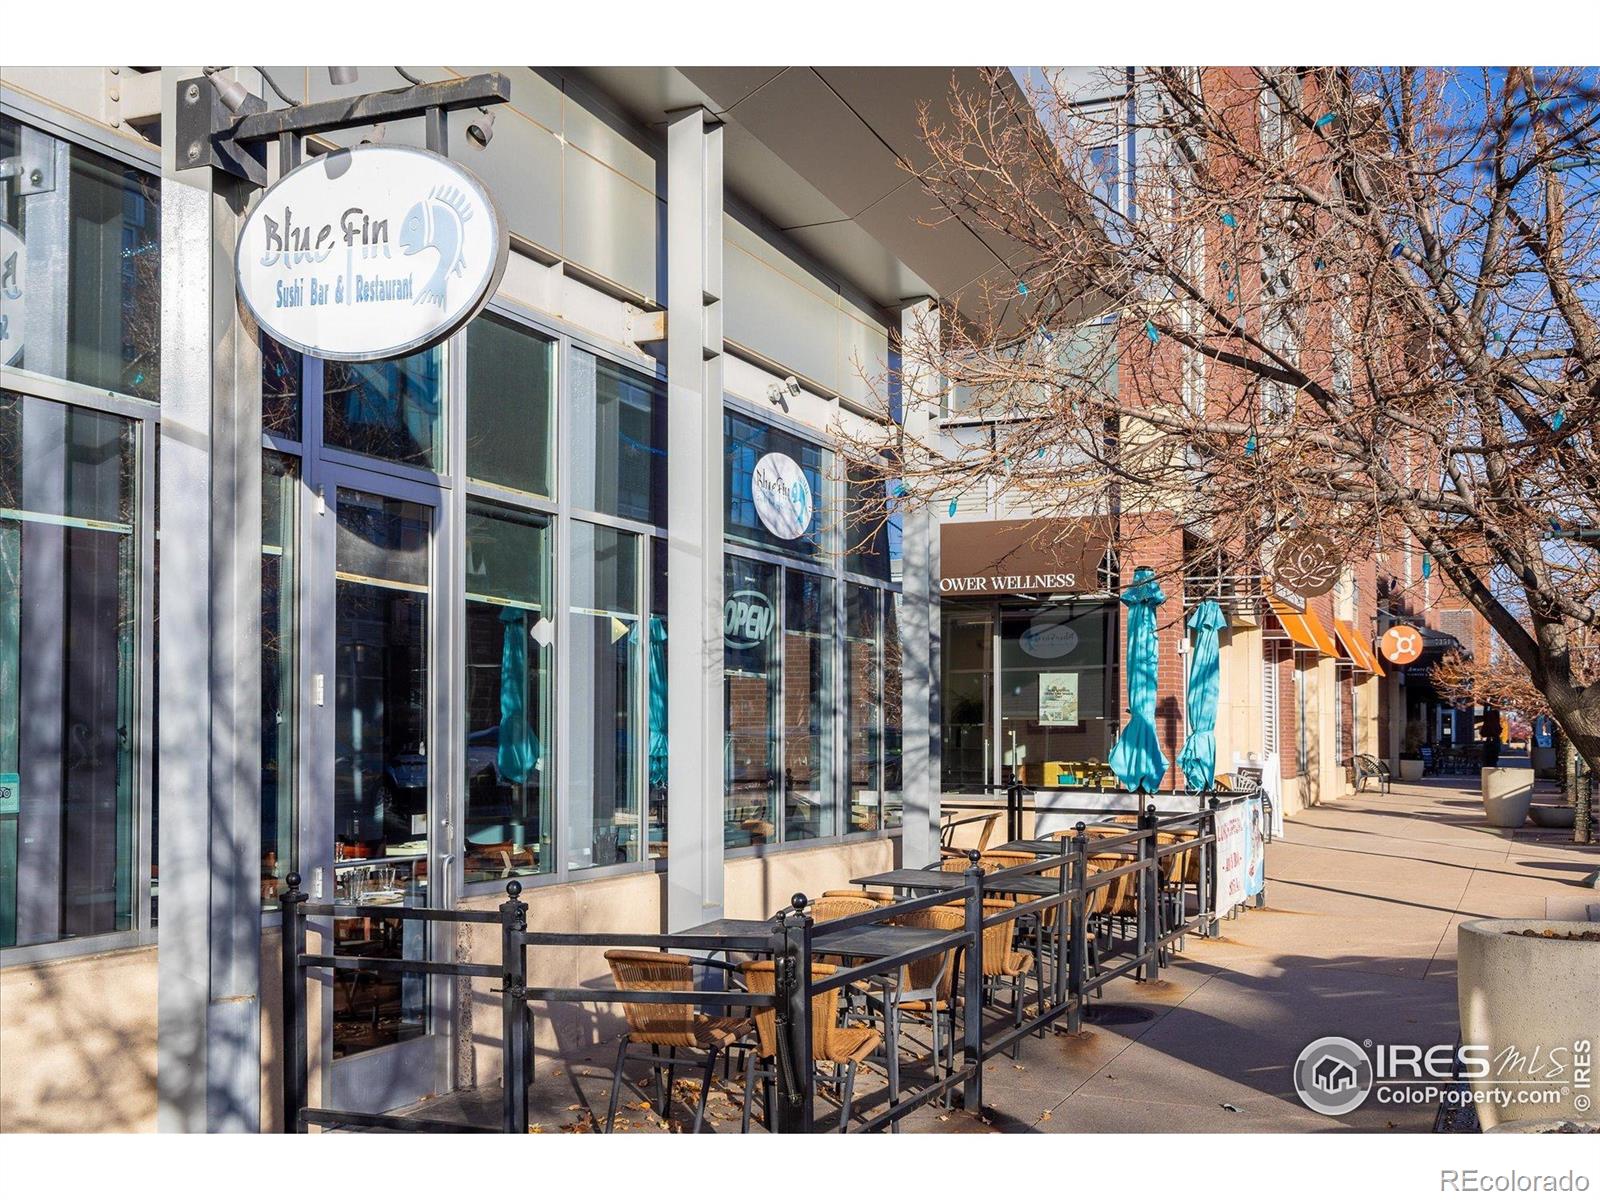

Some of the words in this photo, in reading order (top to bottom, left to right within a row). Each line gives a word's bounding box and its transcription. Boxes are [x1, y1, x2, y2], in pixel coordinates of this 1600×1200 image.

[260, 206, 336, 269] Blue
[340, 207, 391, 262] Fin
[276, 277, 304, 308] Sushi
[310, 276, 329, 306] Bar
[335, 275, 344, 304] &
[356, 272, 413, 303] Restaurant
[940, 577, 987, 592] OWER
[991, 574, 1075, 590] WELLNESS
[724, 600, 770, 641] OPEN
